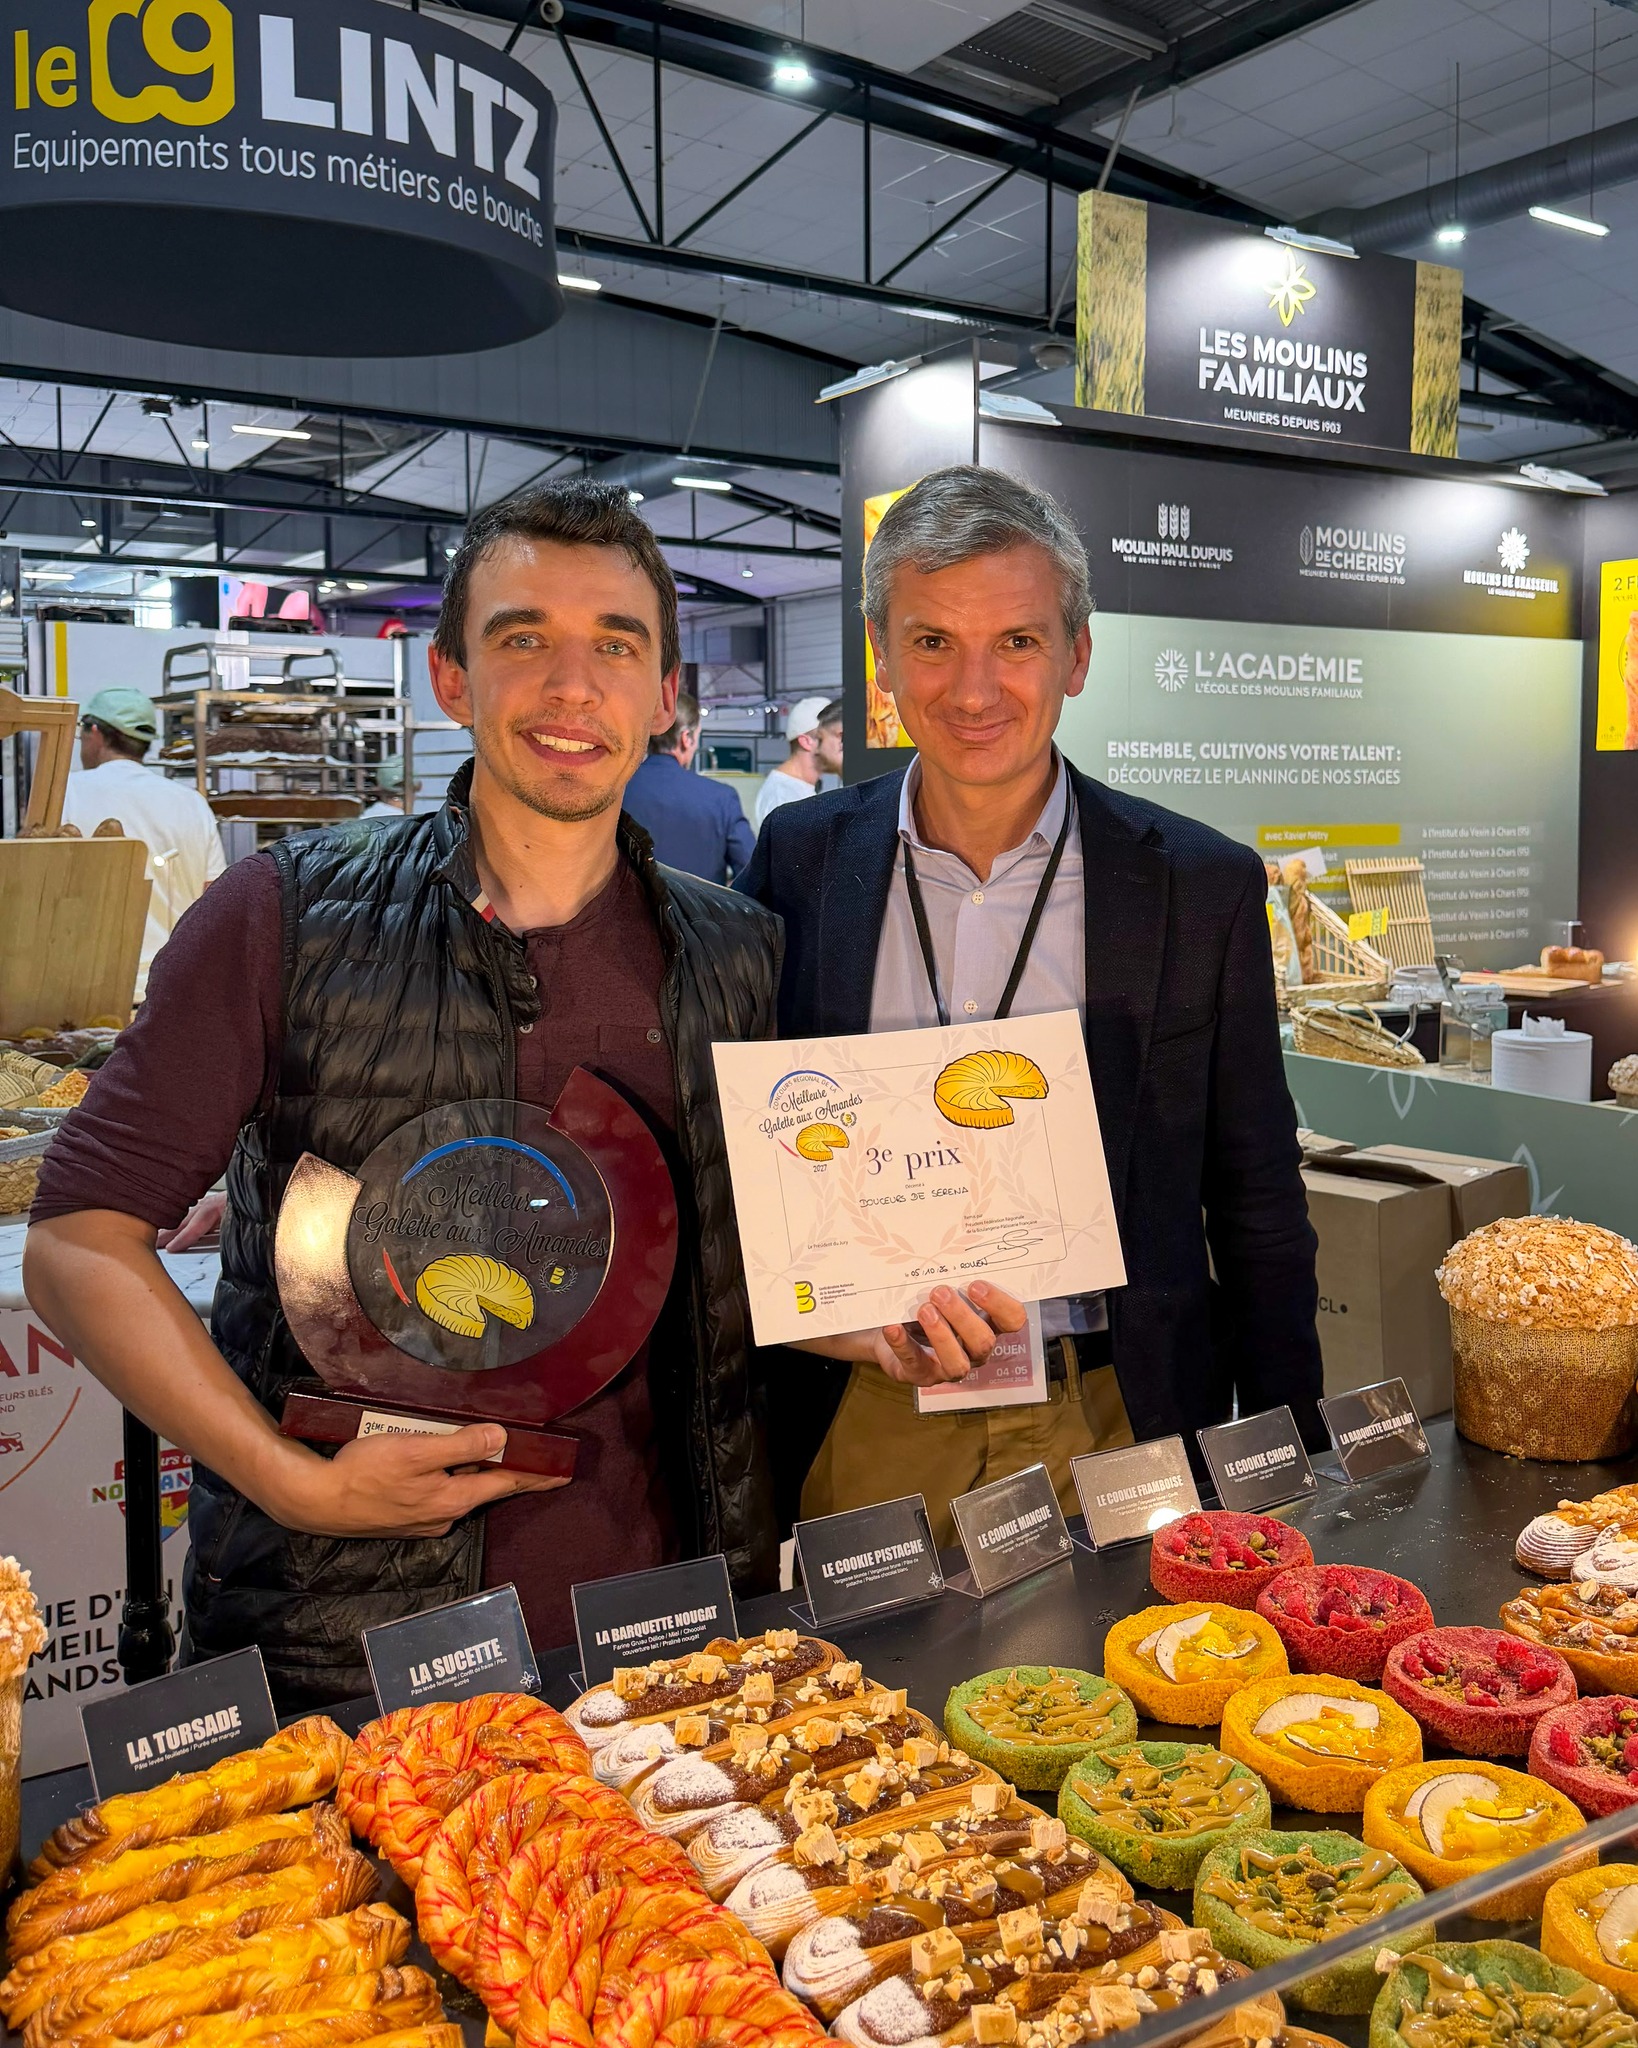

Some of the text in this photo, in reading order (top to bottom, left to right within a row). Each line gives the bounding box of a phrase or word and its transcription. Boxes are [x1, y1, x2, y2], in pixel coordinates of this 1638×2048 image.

[14, 29, 77, 110] le
[259, 14, 542, 200] LINTZ
[13, 132, 544, 249] Equipements tous métiers de bouche
[1199, 326, 1368, 379] LES MOULINS
[1198, 357, 1367, 413] FAMILIAUX
[1223, 406, 1342, 434] MEUNIERS DEPUIS 1903
[1111, 537, 1233, 563] MOULIN PAUL DUPUIS
[1316, 526, 1406, 555] MOULINS
[1316, 549, 1332, 562] DE
[1195, 681, 1364, 699] L'ÉCOLE DES MOULINS FAMILIAUX
[1107, 741, 1197, 762] ENSEMBLE,
[1200, 742, 1287, 761] CULTIVONS
[1289, 744, 1339, 761] VOTRE
[1340, 745, 1395, 761] TALENT
[1107, 763, 1400, 785] DÉCOUVREZ LE PLANNING DE NOS STAGES
[772, 1080, 793, 1110] CONCOURS
[781, 1088, 827, 1113] Meilleure
[759, 1116, 795, 1139] Galette
[796, 1113, 813, 1124] aux
[815, 1093, 863, 1120] Amandes
[904, 1140, 963, 1181] prix
[859, 1186, 969, 1208] DOUCEURS DE SERENA
[353, 1201, 609, 1265] Galette aux Amandes
[28, 1385, 54, 1398] BLÉS
[1339, 1431, 1350, 1446] LA
[1347, 1422, 1384, 1443] BARQUETTE
[1400, 1411, 1415, 1425] LAIT
[1223, 1462, 1237, 1478] LE
[1234, 1452, 1269, 1475] COOKIE
[1265, 1443, 1297, 1465] CHOCO
[1096, 1494, 1107, 1507] LE
[1106, 1486, 1139, 1505] COOKIE
[1136, 1474, 1184, 1497] FRAMBOISE
[977, 1532, 990, 1550] LE
[987, 1519, 1020, 1545] COOKIE
[1017, 1504, 1053, 1531] MANGUE
[821, 1538, 925, 1579] LE COOKIE PISTACHE
[594, 1604, 718, 1646] LA BARQUETTE NOUGAT
[408, 1637, 503, 1688] LA SUCETTE
[126, 1705, 242, 1765] LA TORSADE
